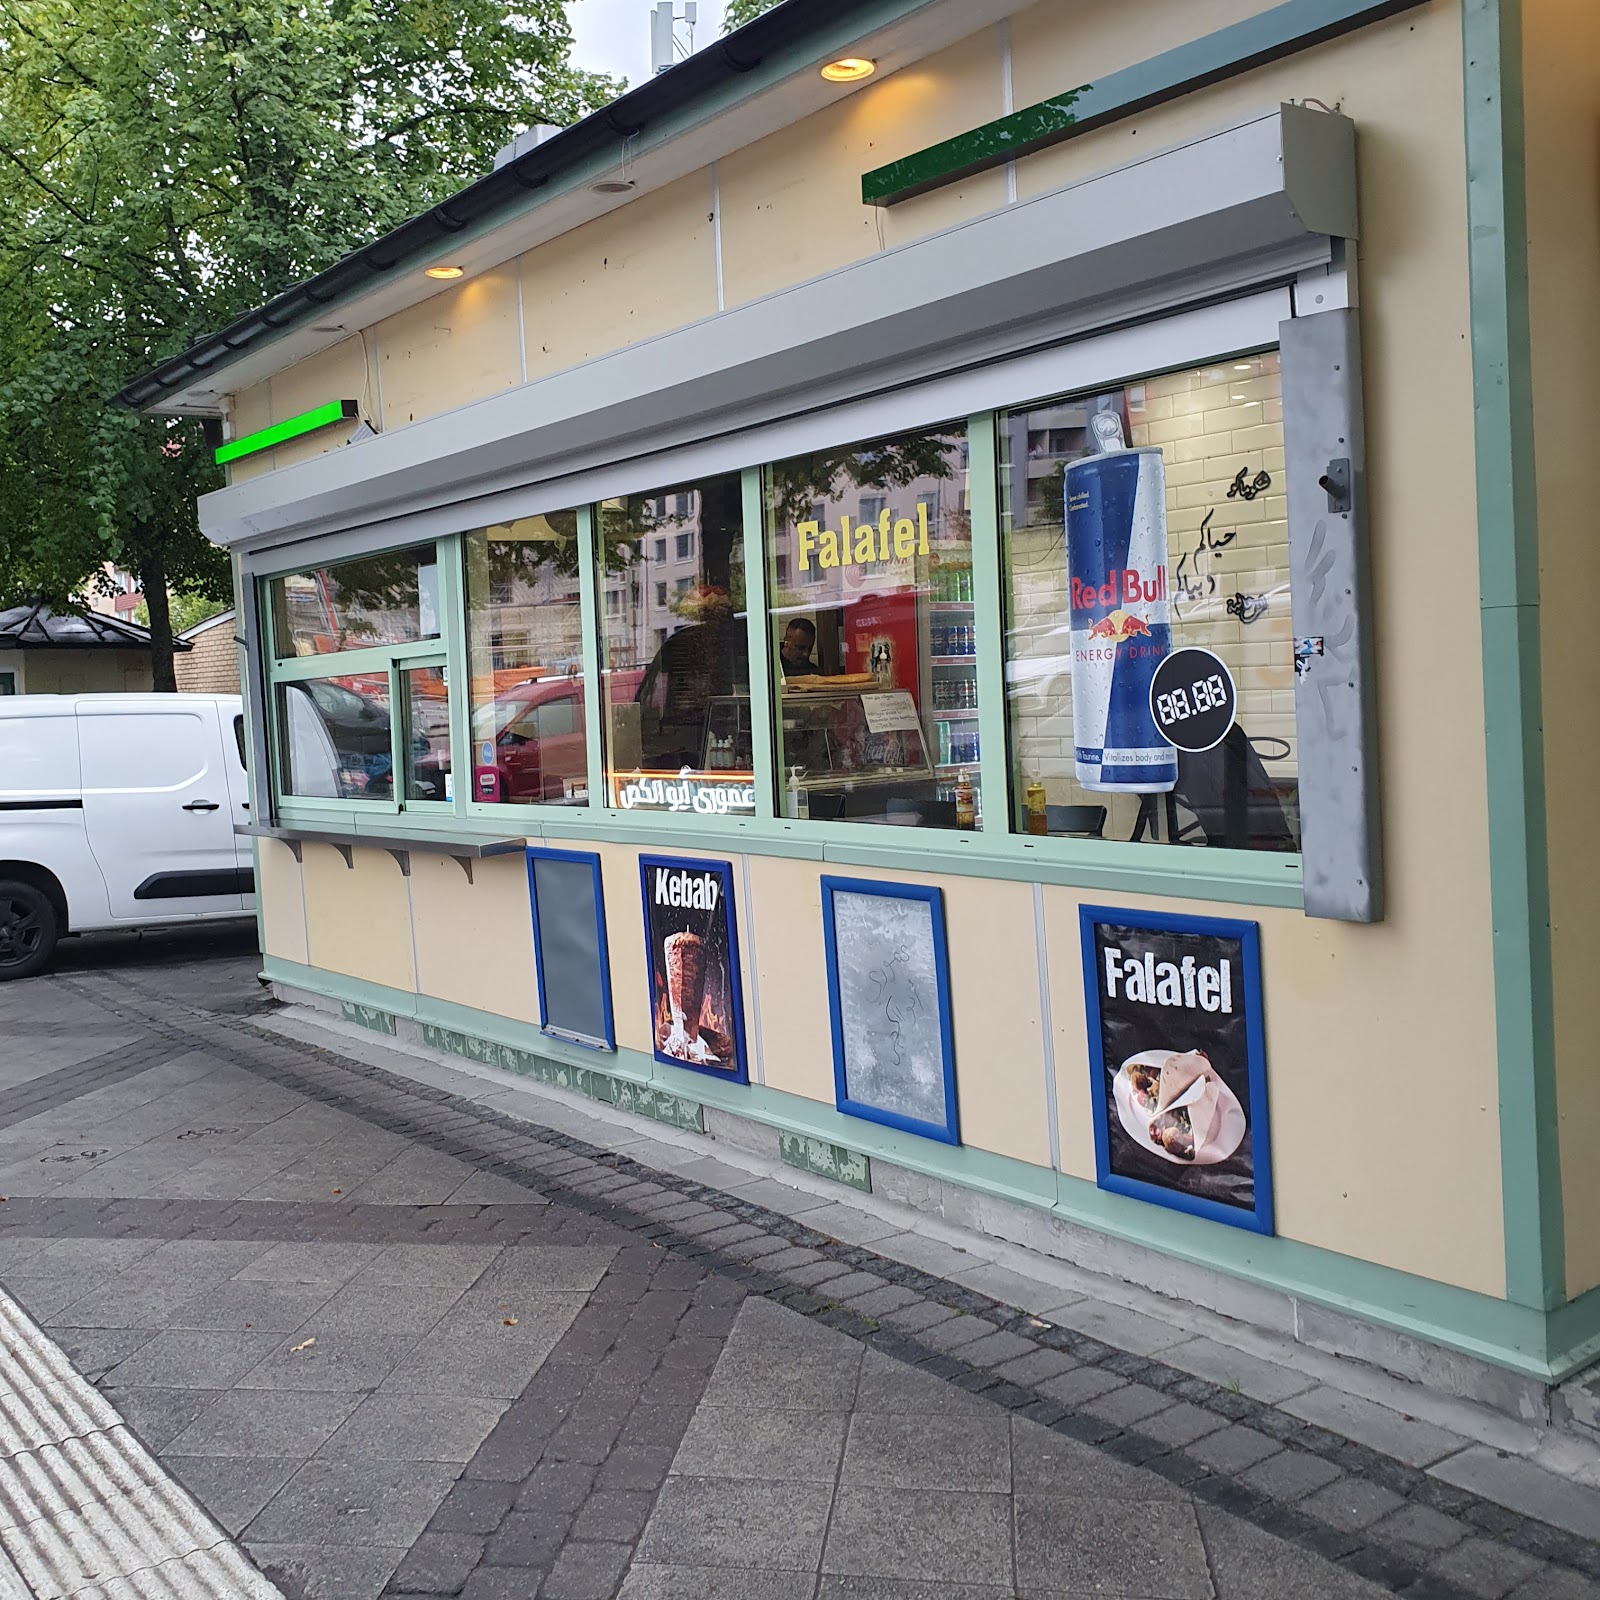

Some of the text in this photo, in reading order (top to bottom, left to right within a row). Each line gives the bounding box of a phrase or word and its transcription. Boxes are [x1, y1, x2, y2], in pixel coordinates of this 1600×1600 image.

[797, 502, 930, 571] Falafel
[1071, 565, 1166, 610] Red Bull
[1076, 644, 1166, 662] ENERGY DRINK
[1157, 674, 1228, 726] 88.88
[1104, 753, 1134, 763] Vitalizes
[1135, 752, 1152, 764] body
[1153, 752, 1165, 761] and
[655, 867, 718, 911] Kebab
[1104, 946, 1233, 1014] Falafel
